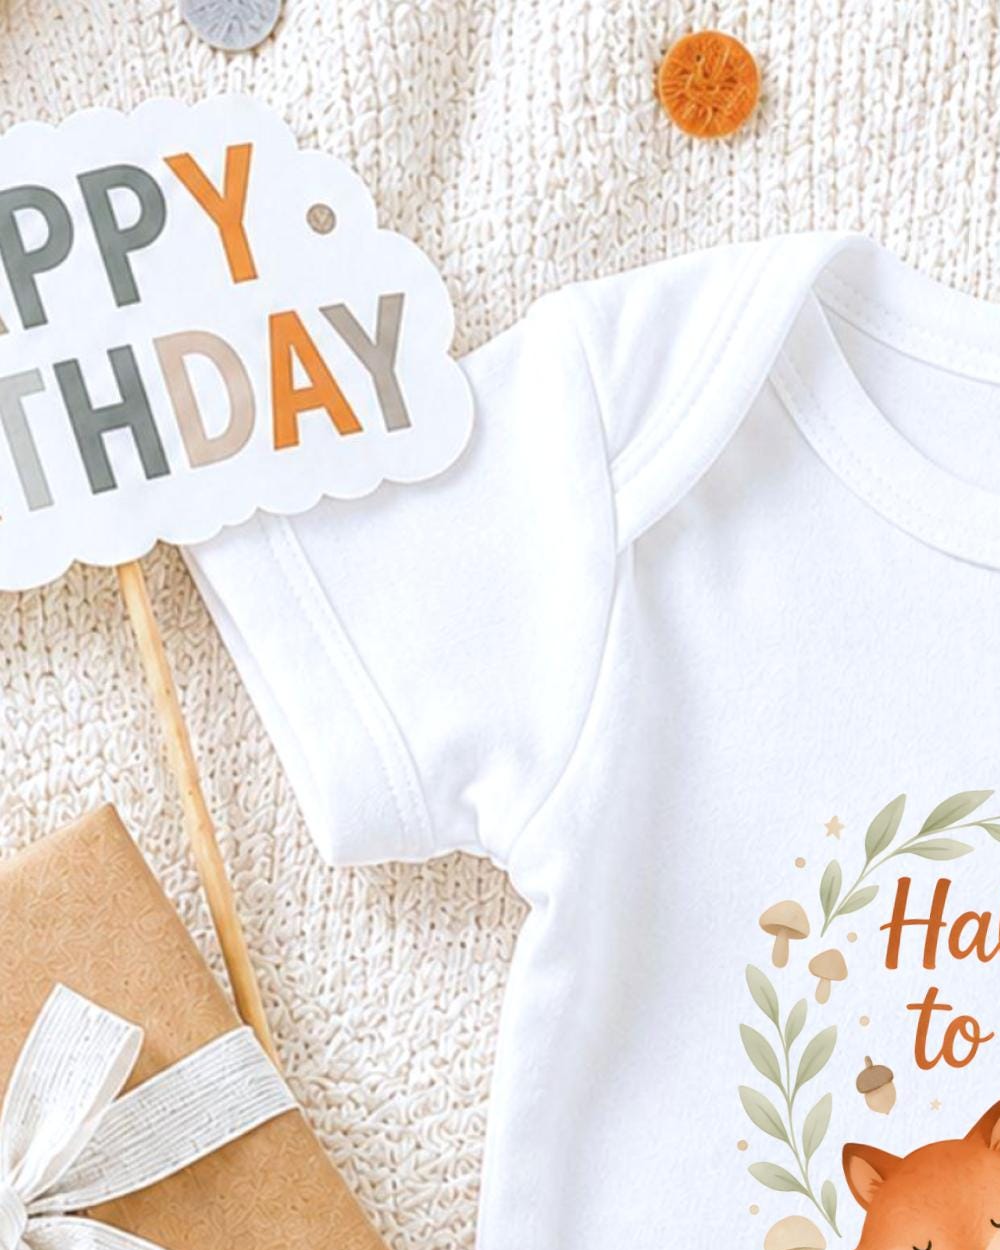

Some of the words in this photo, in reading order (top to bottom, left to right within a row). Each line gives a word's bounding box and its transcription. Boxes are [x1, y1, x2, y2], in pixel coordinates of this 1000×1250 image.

[0, 141, 259, 337] PPY
[0, 292, 412, 518] THDAY
[906, 986, 995, 1071] to
